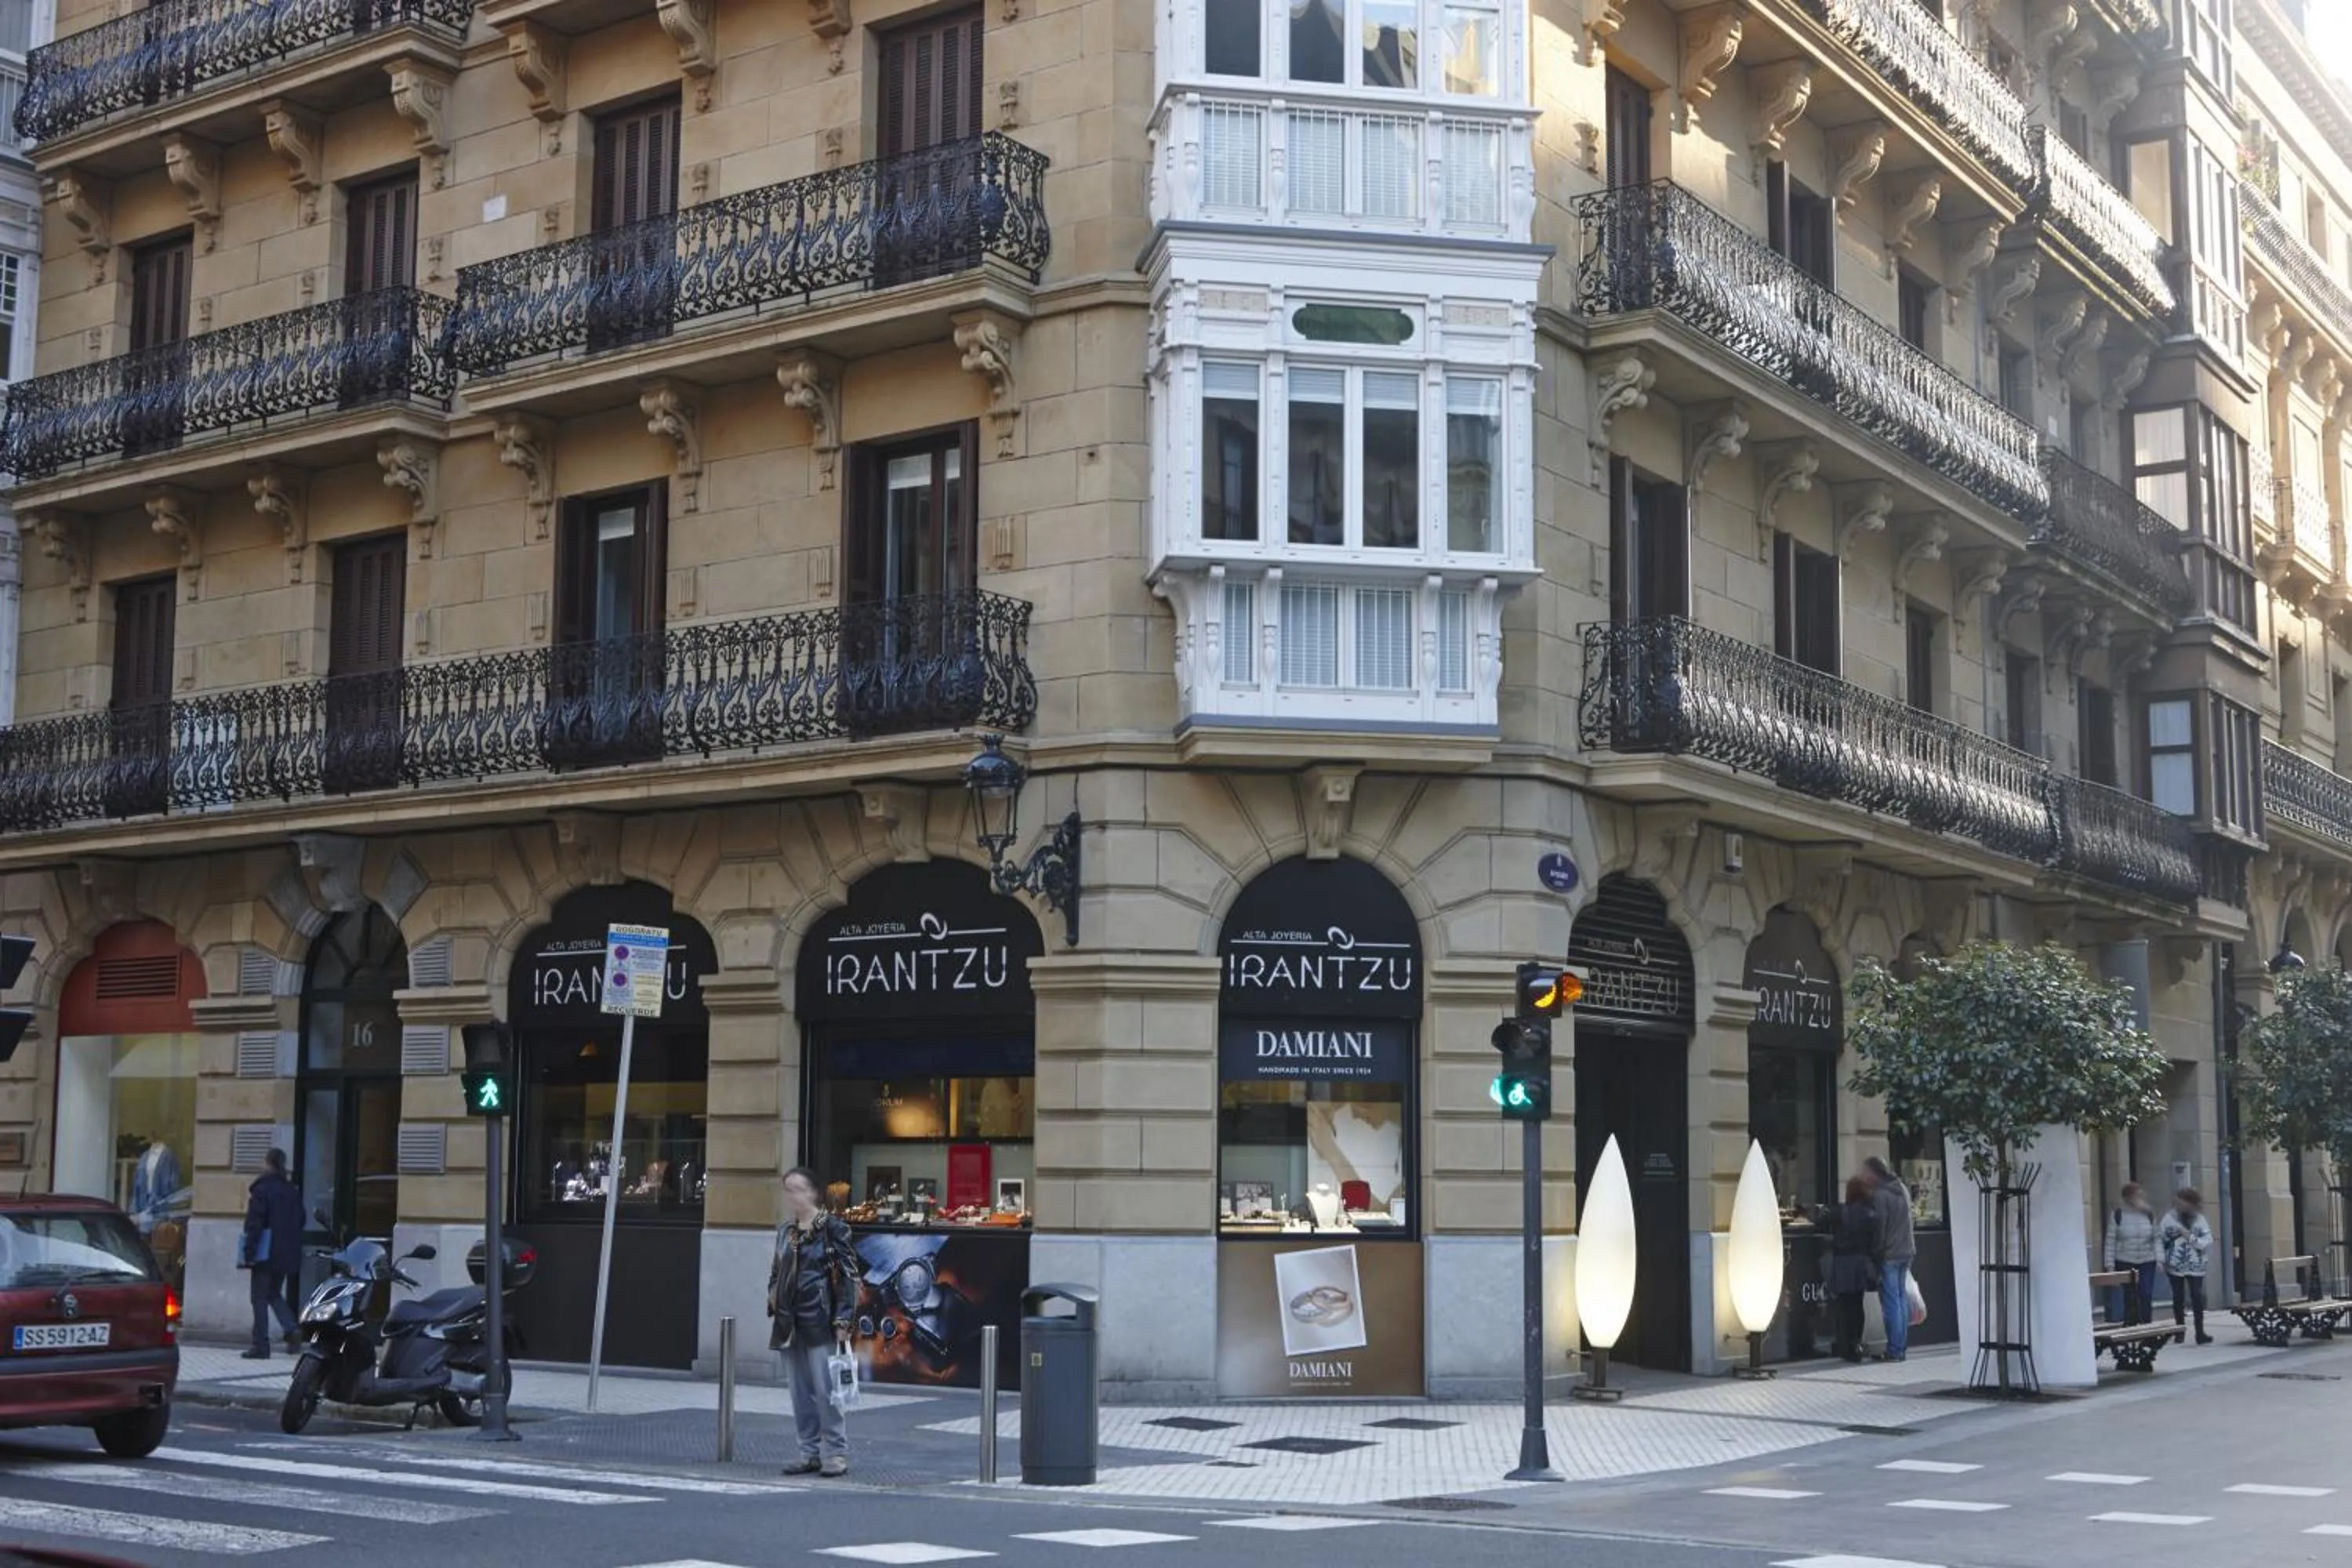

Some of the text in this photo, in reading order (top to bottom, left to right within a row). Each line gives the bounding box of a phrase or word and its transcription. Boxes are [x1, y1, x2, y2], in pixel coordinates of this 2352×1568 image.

[840, 924, 862, 935] ALTA
[1242, 931, 1267, 940] ALTA
[827, 946, 1007, 994] IRANTZU
[1230, 954, 1411, 990] IRANTZU
[1588, 967, 1679, 1015] RANTZU
[1758, 986, 1831, 1029] RANTZU
[353, 1021, 374, 1047] 16
[1256, 1030, 1373, 1058] DAMIANI
[1289, 1362, 1353, 1377] DAMIANI
